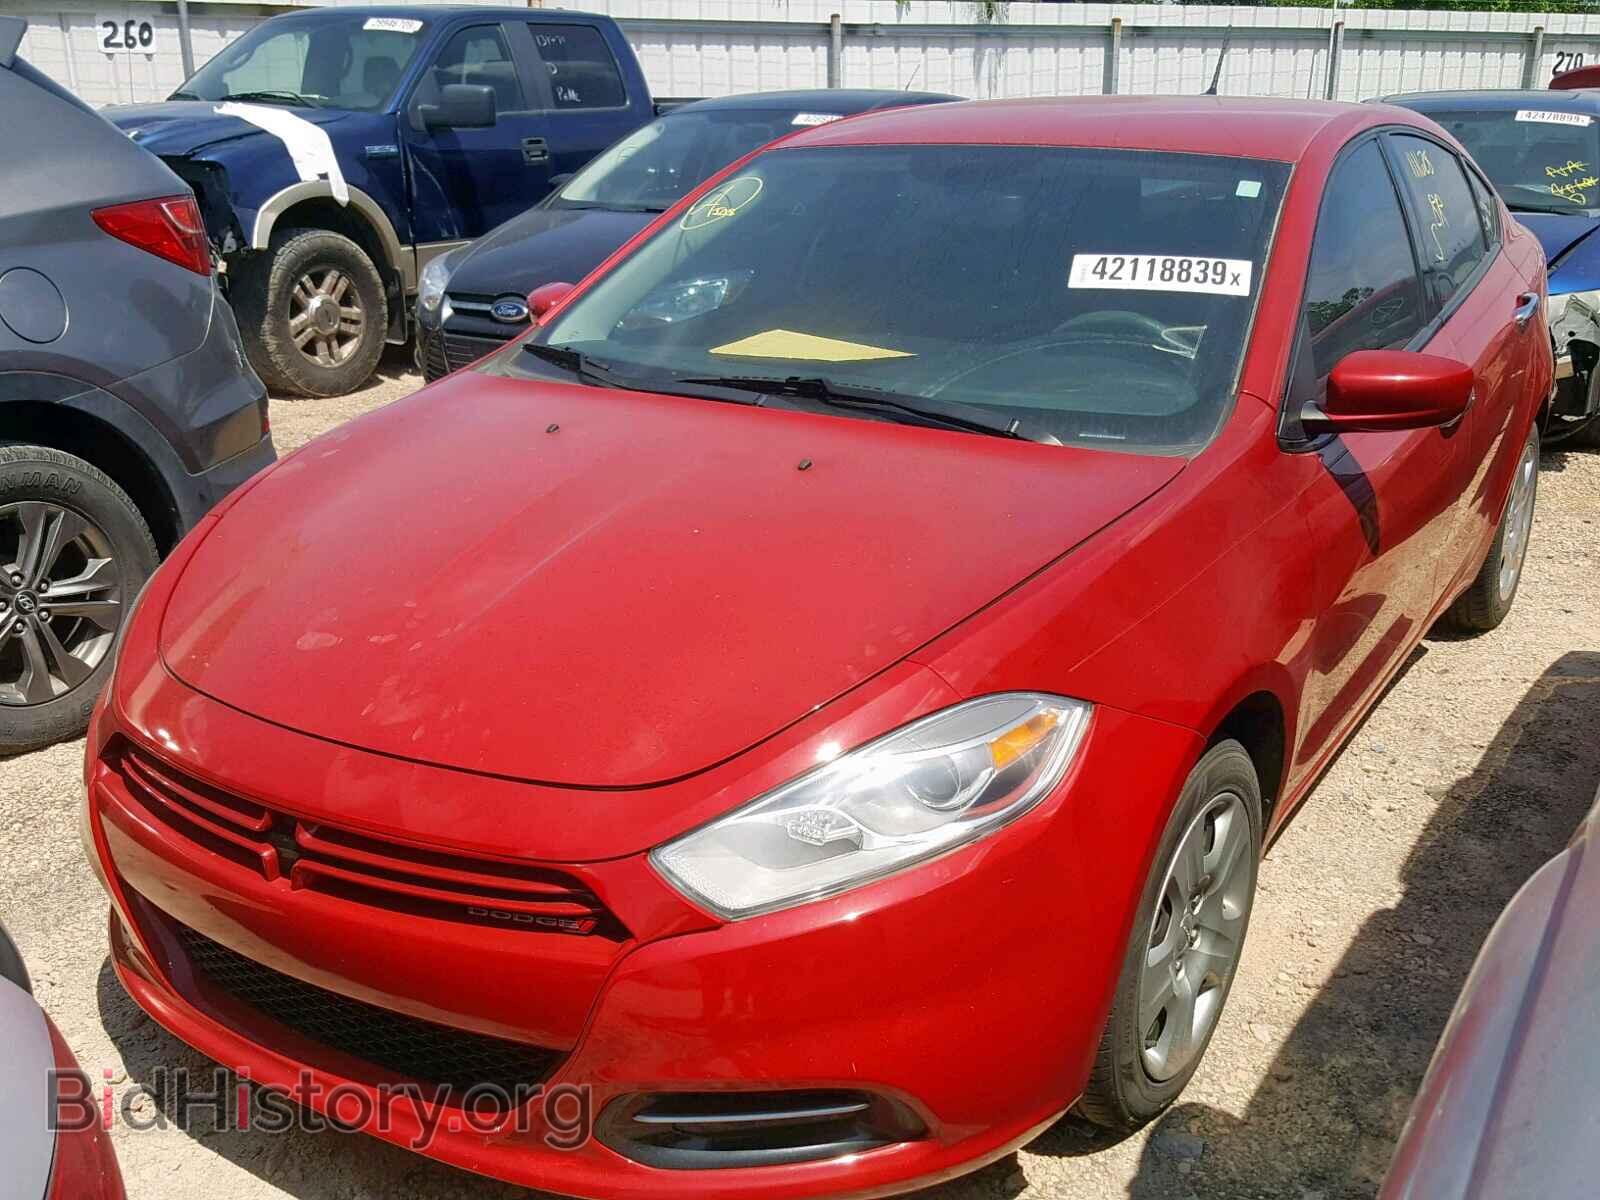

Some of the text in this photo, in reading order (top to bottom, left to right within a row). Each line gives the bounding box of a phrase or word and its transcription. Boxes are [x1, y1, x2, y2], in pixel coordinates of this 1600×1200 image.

[103, 20, 153, 49] 260
[1552, 51, 1584, 75] 270
[497, 304, 518, 317] Ford
[467, 906, 580, 930] DODGE
